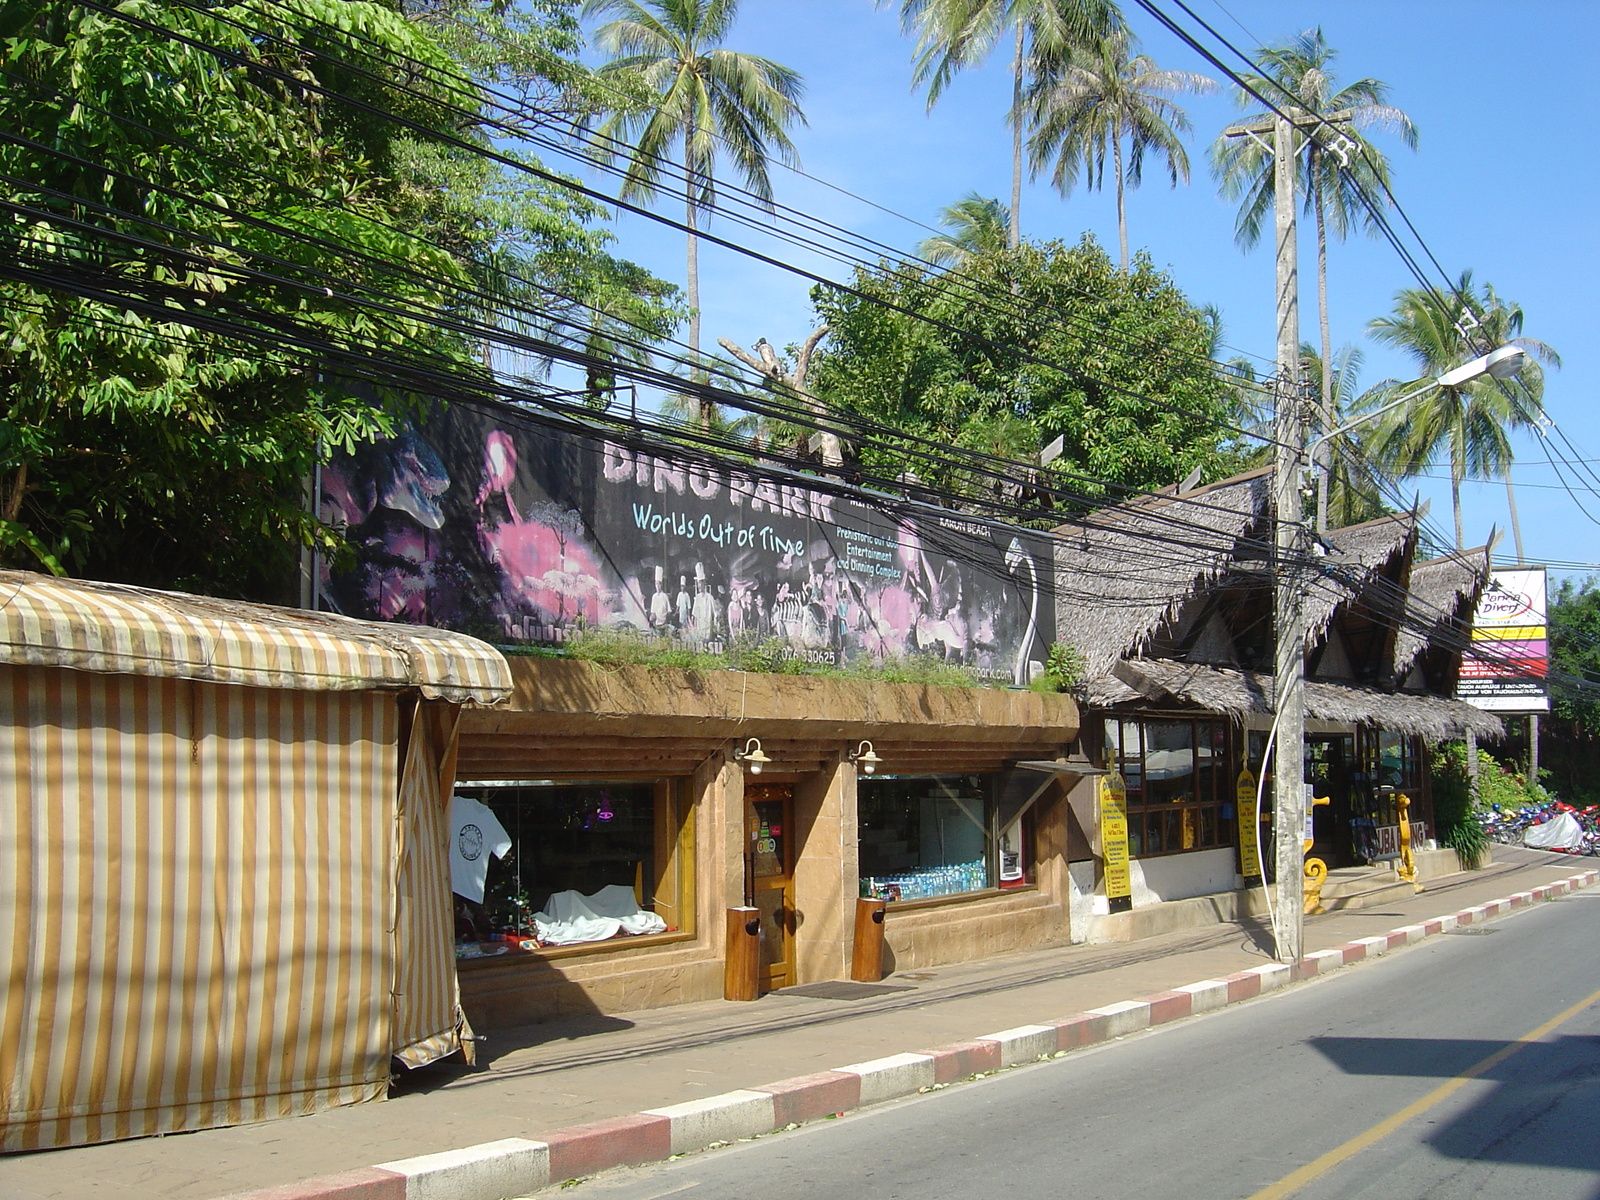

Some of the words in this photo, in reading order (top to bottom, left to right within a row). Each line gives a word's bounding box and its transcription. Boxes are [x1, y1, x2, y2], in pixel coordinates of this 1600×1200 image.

[603, 439, 721, 500] DINO
[729, 470, 836, 524] PARK
[632, 502, 695, 539] Worlds
[698, 513, 734, 548] Out
[737, 524, 756, 548] of
[759, 525, 805, 557] Time
[836, 526, 873, 544] Prehistoric
[967, 522, 991, 538] BEACH
[846, 542, 892, 563] Entertainment
[837, 556, 849, 569] and
[850, 558, 875, 577] Dinning
[875, 563, 902, 579] Complex
